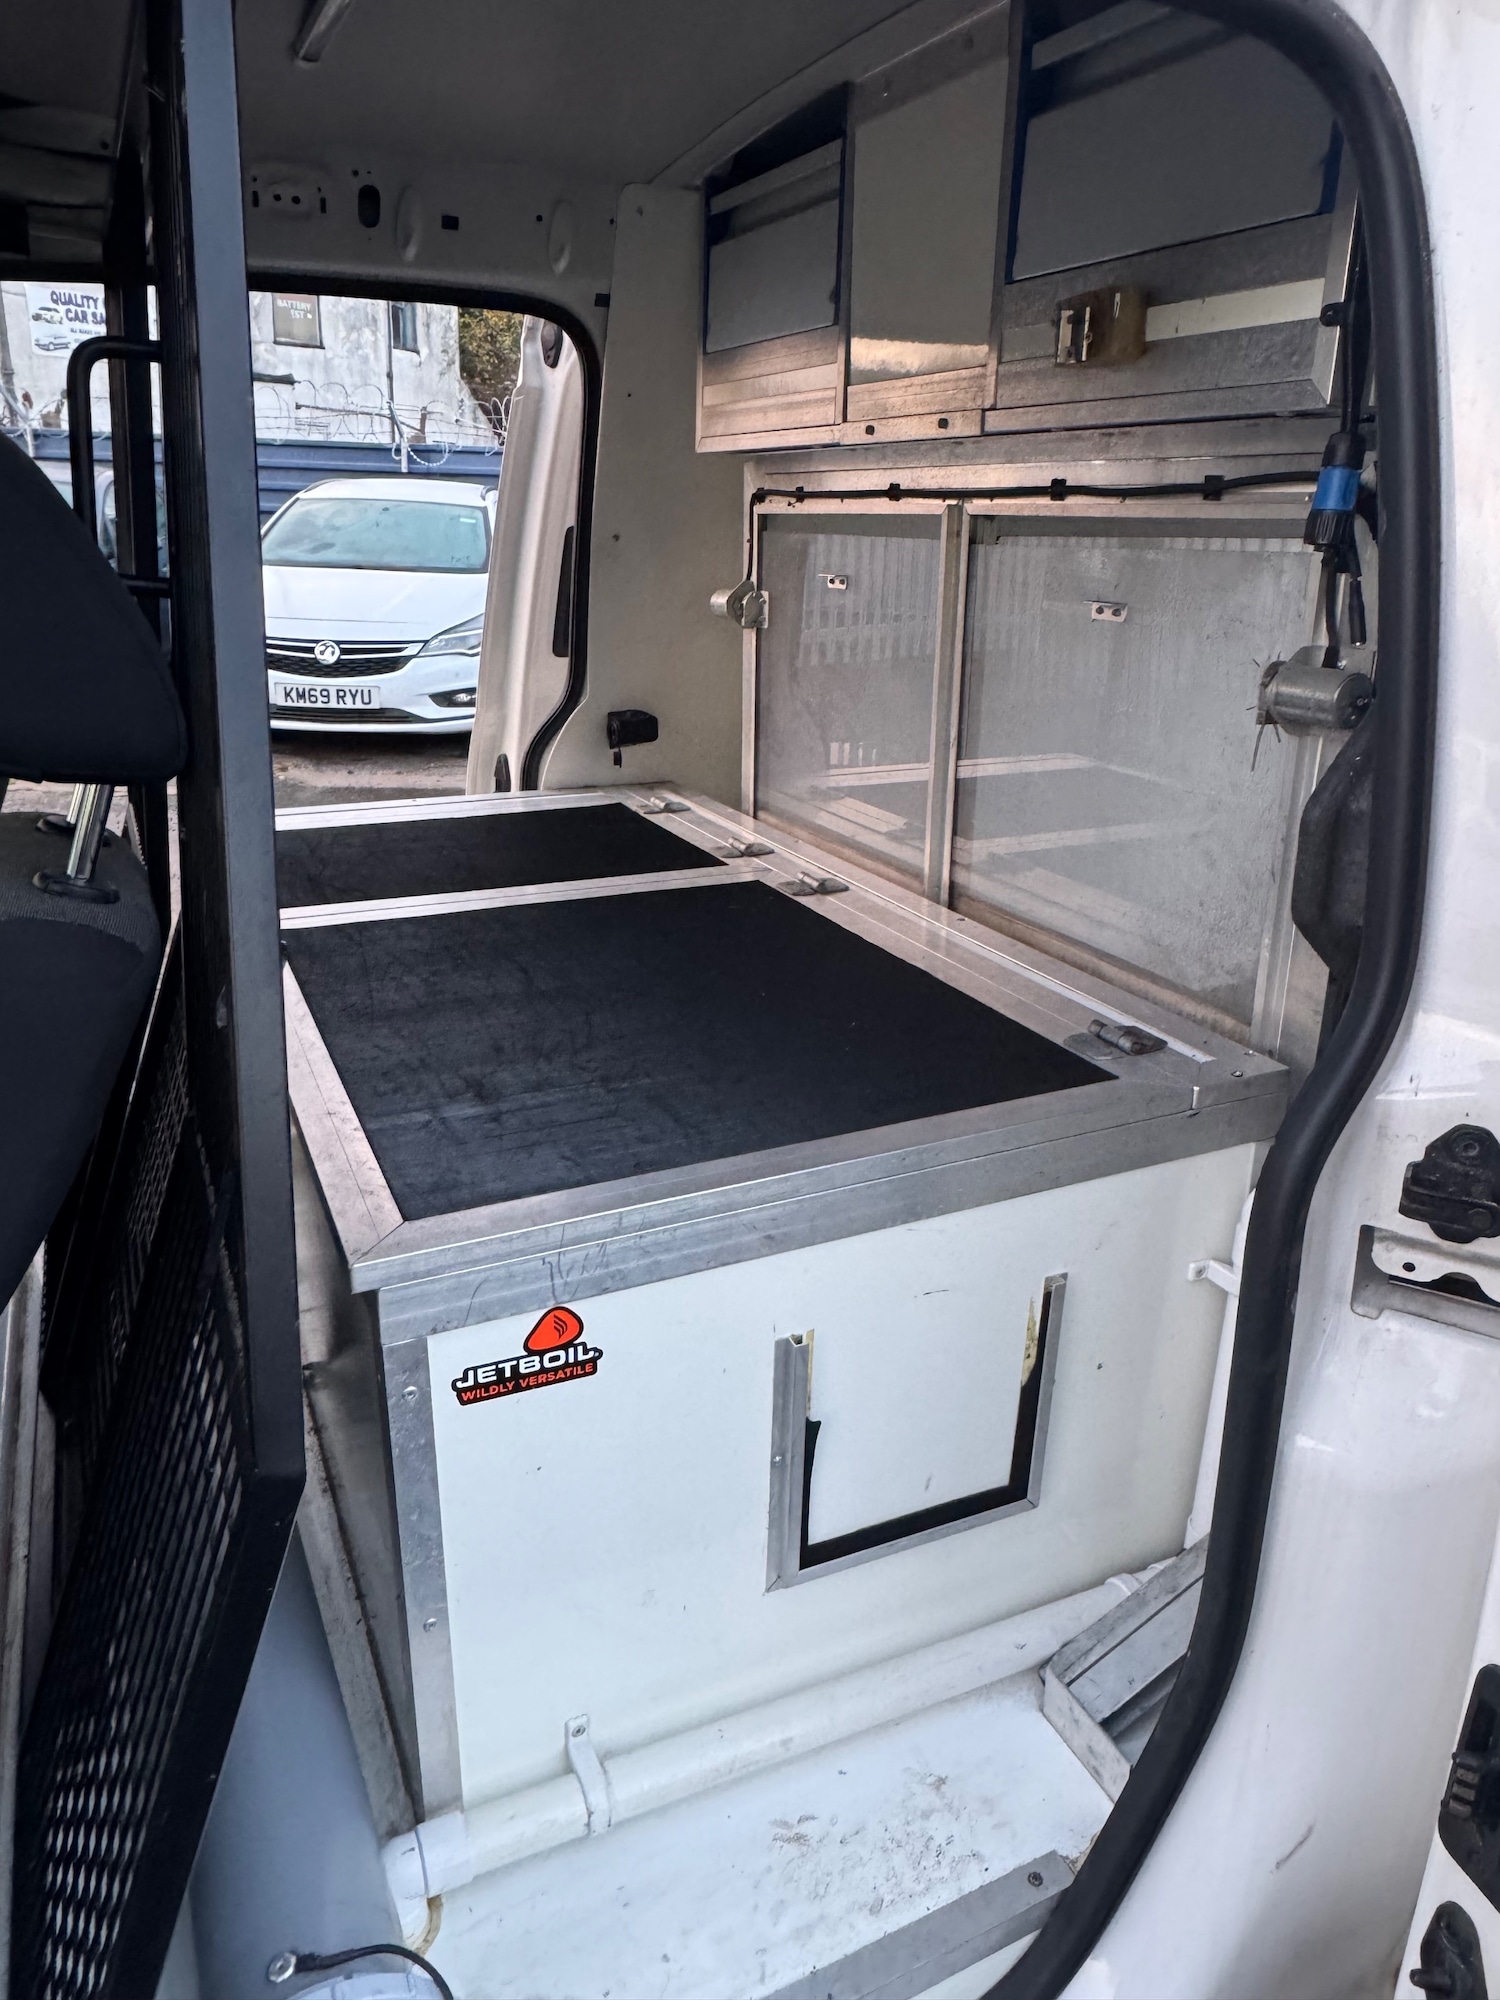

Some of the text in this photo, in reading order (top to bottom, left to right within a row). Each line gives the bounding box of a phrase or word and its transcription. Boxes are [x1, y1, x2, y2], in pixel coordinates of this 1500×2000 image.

[50, 290, 99, 310] QUALITY
[276, 299, 311, 311] BATTERY
[65, 308, 89, 324] CAR
[284, 686, 372, 705] KM69 RYU
[455, 1345, 596, 1388] JETBOIL
[461, 1362, 594, 1401] WILDLY VERSATILE
